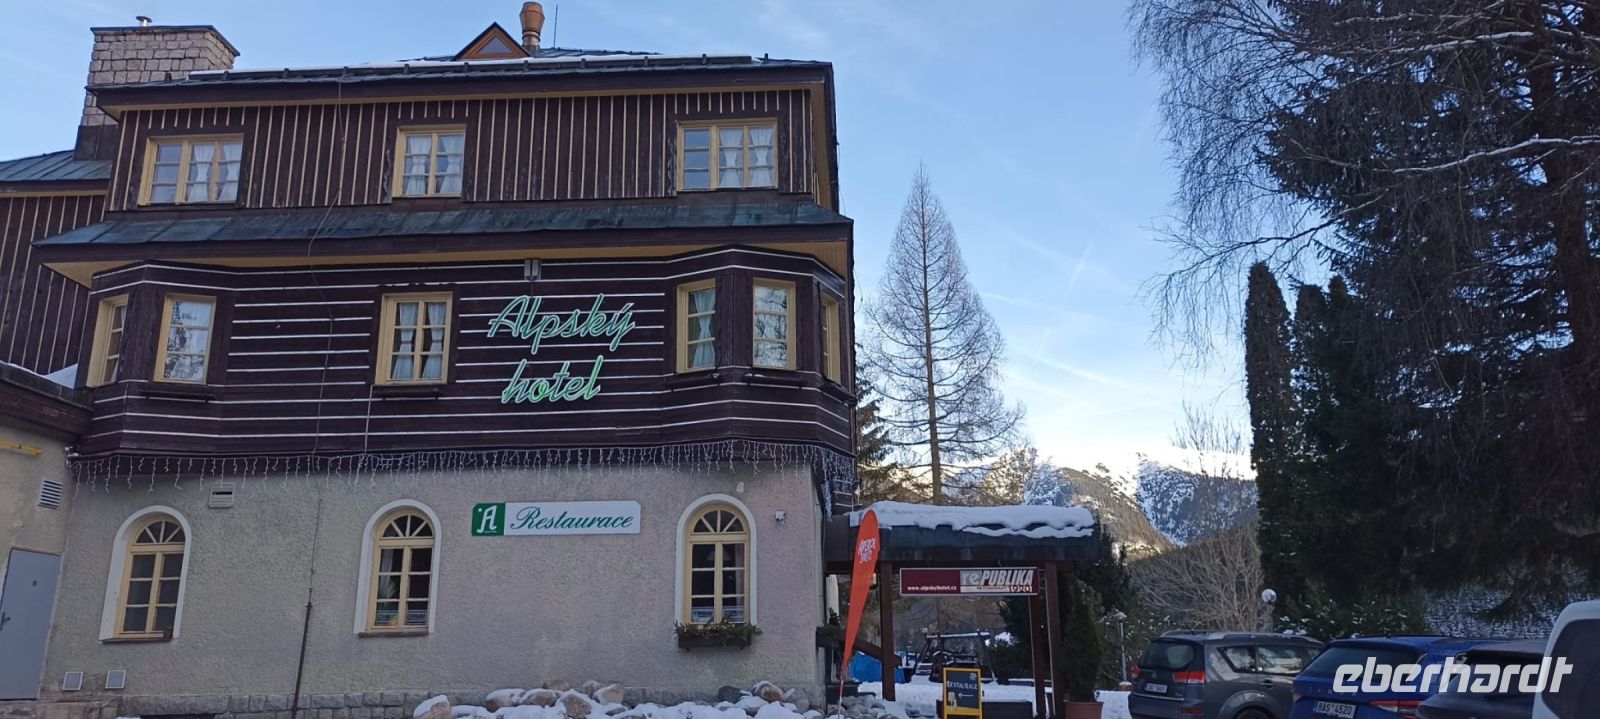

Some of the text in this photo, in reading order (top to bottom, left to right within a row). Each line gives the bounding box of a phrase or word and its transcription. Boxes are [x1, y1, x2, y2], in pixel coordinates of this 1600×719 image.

[487, 294, 635, 354] Alpský
[501, 355, 603, 403] hotel
[511, 506, 634, 529] Restaurace
